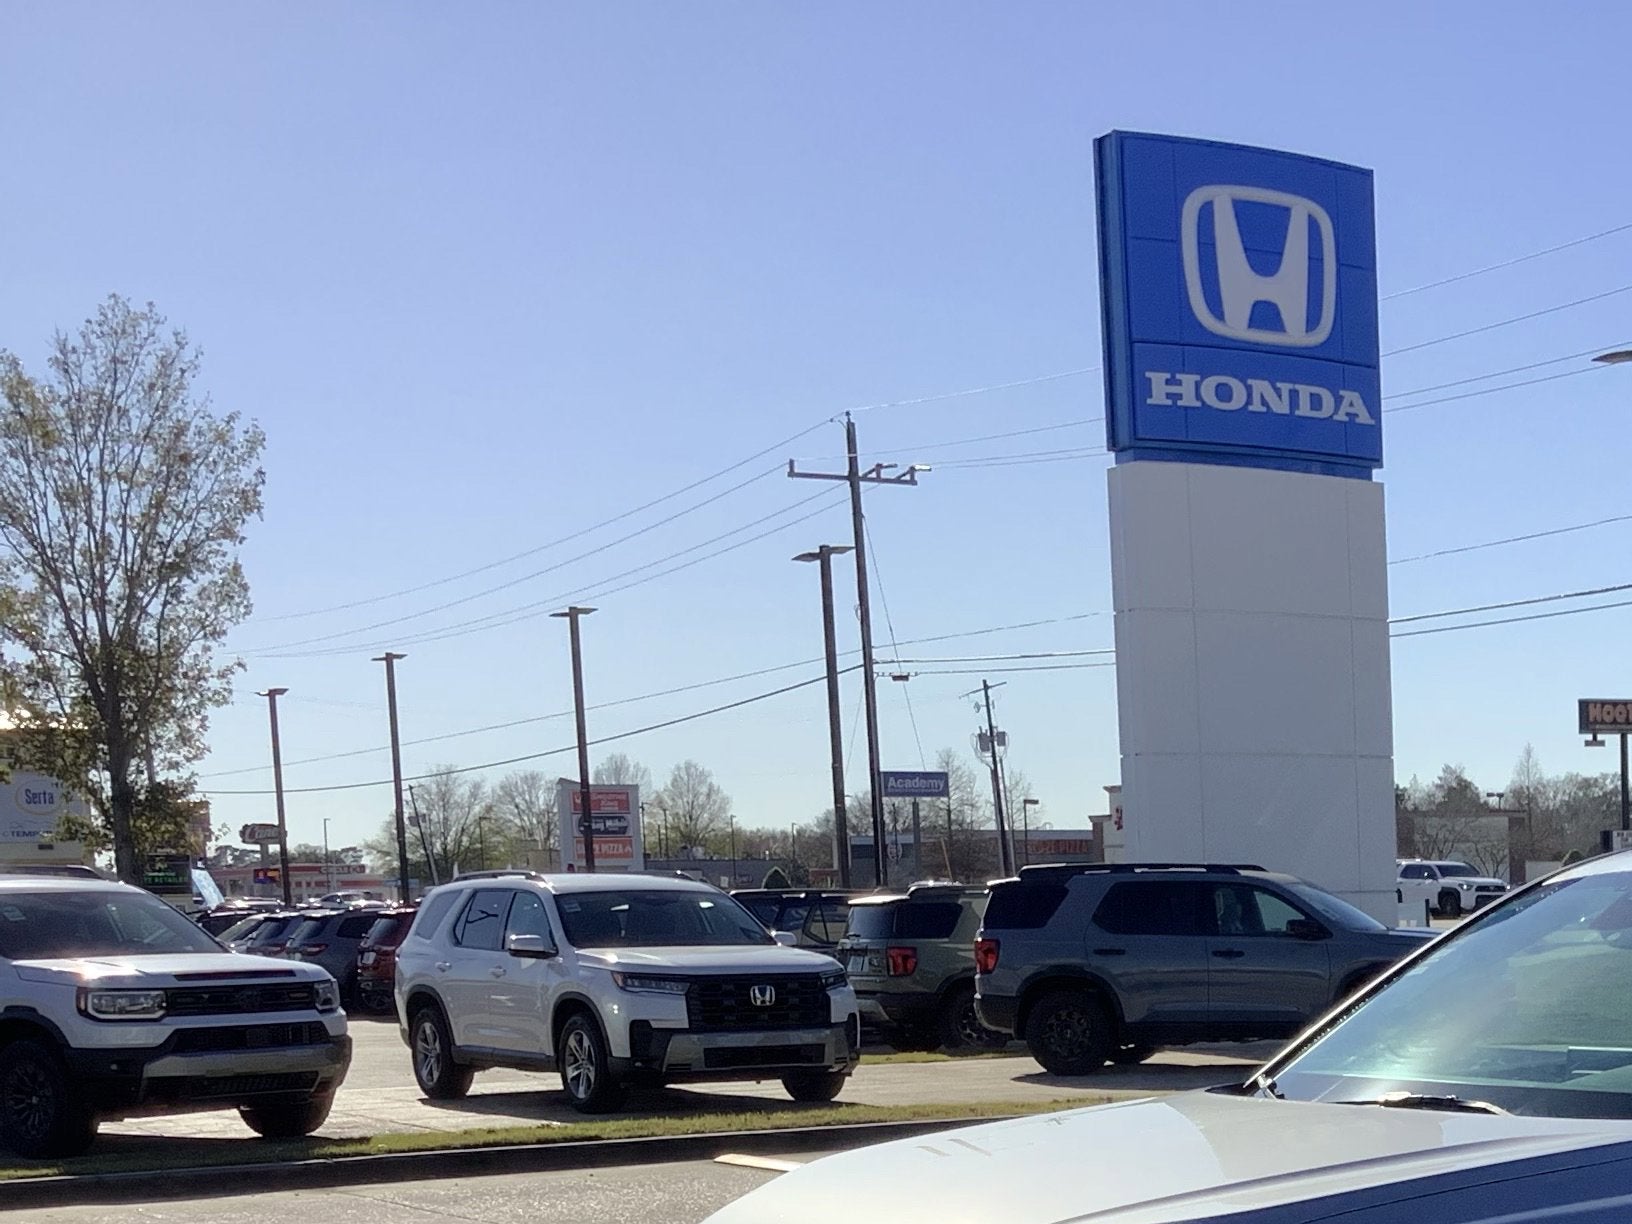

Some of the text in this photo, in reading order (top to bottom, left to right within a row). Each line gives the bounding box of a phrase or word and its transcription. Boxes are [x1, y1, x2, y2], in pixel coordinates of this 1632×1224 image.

[1145, 371, 1376, 426] HONDA
[887, 776, 945, 792] Academy
[24, 788, 55, 805] Serta
